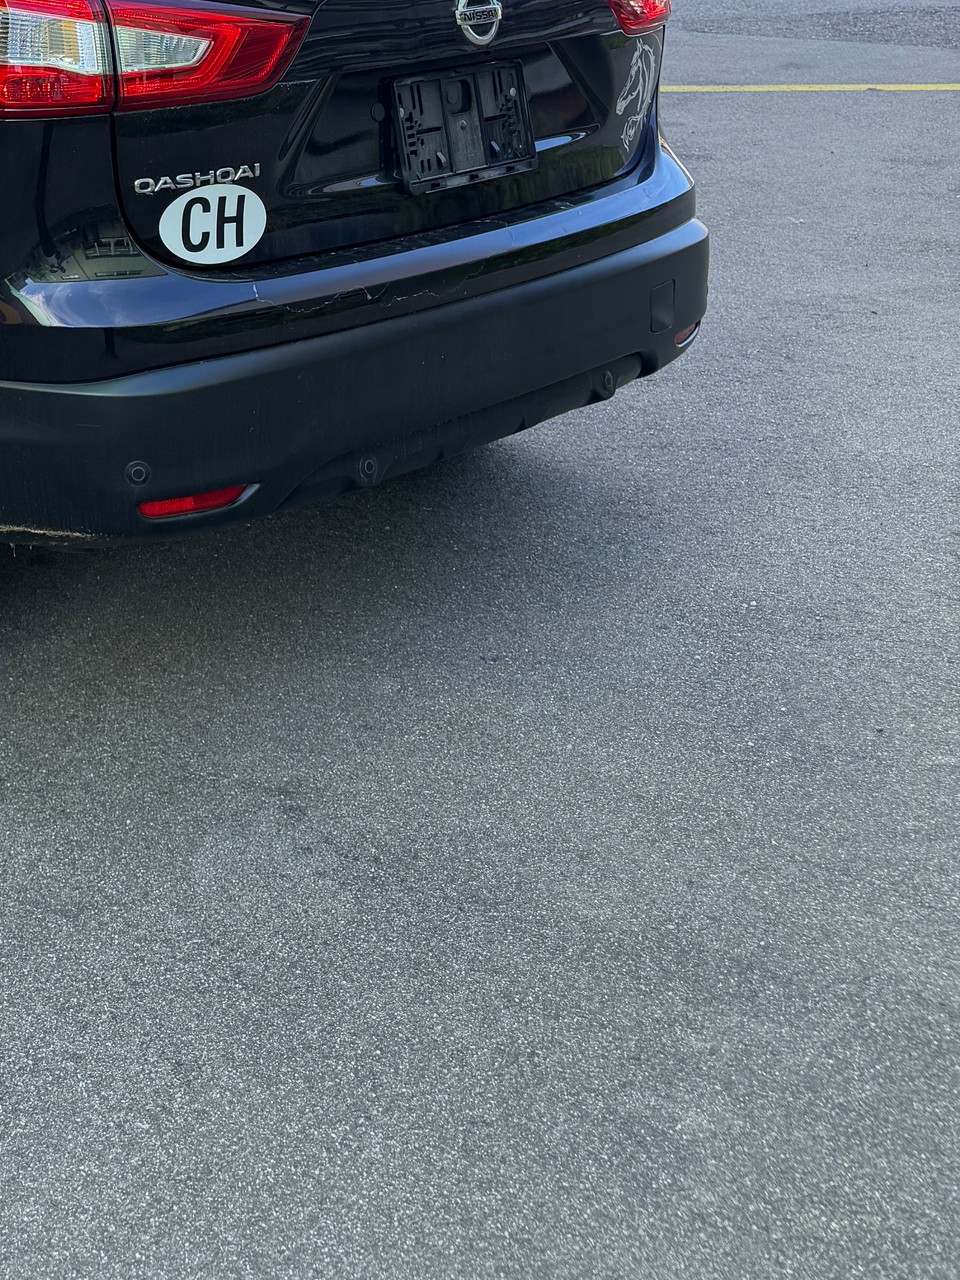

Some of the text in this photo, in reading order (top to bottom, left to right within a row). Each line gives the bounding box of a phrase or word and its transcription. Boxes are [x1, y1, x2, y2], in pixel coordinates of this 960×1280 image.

[464, 9, 498, 21] NISSAN
[134, 163, 260, 195] QASHQAI
[181, 194, 246, 253] CH
